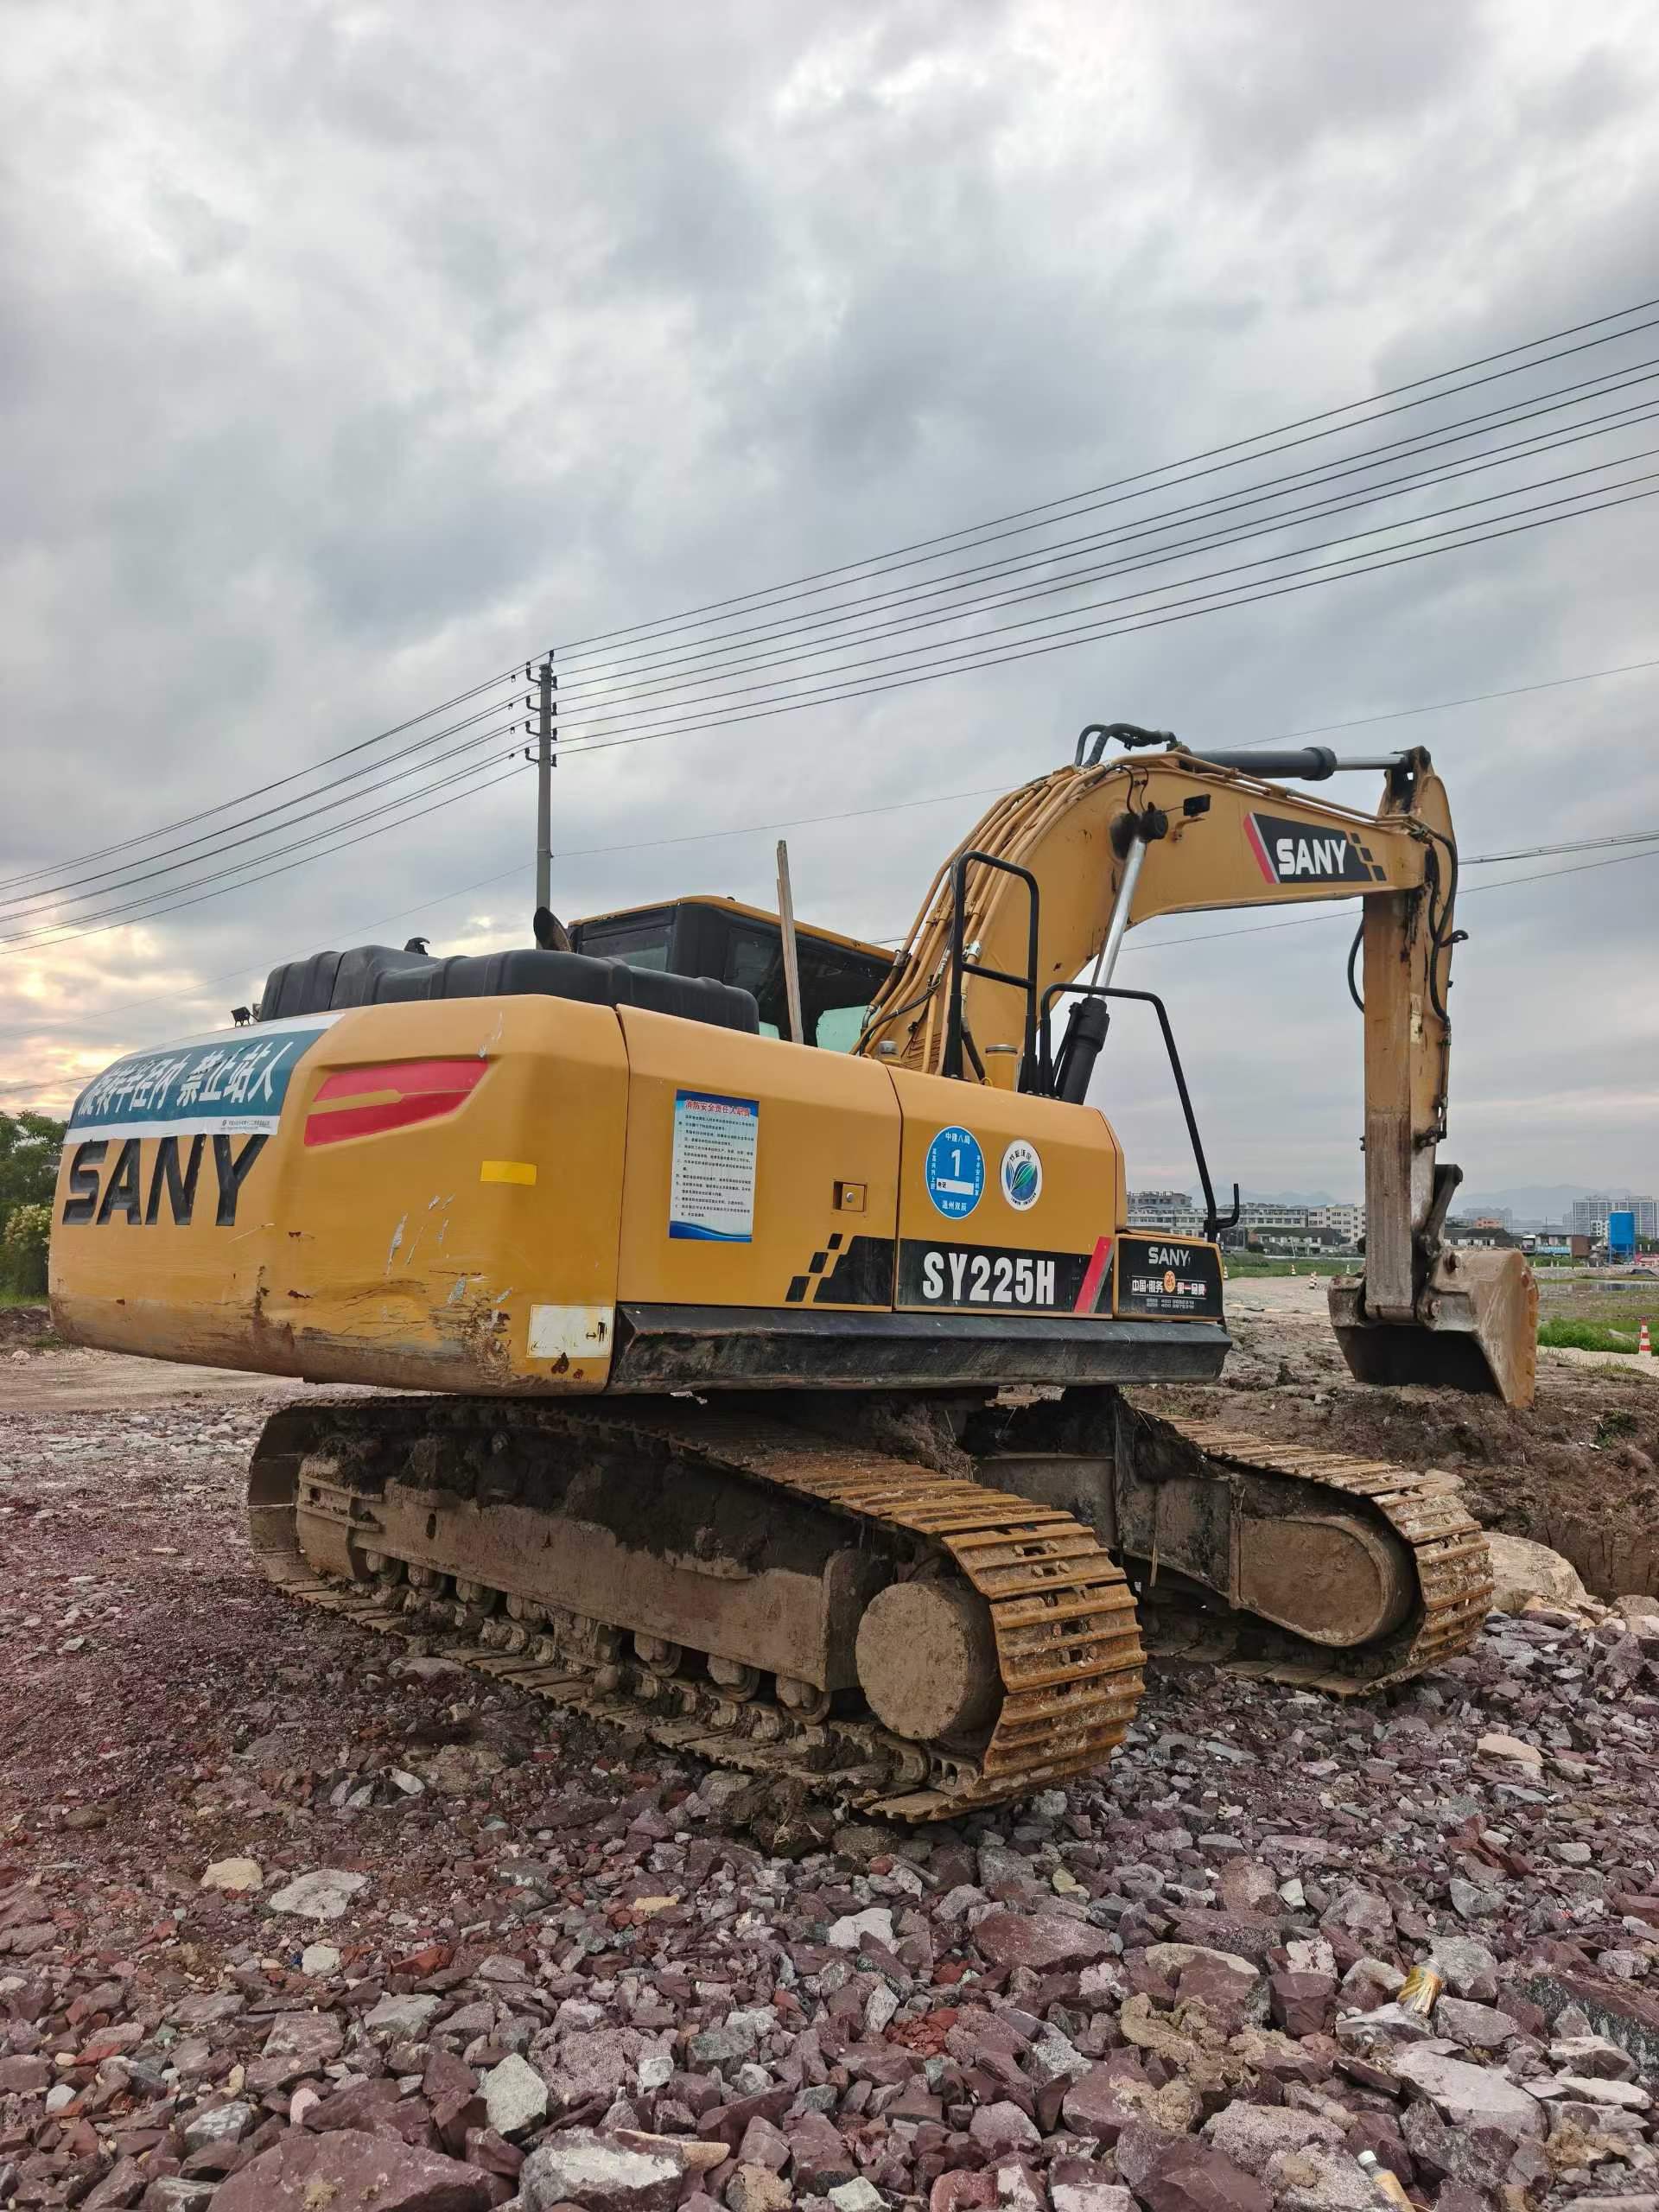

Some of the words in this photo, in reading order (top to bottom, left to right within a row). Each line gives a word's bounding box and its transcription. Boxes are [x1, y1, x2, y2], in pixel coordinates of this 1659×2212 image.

[1275, 838, 1347, 874] SANY
[176, 1040, 294, 1106] 禁止站人
[945, 1131, 970, 1145] 中建八局
[951, 1149, 961, 1177] 1
[62, 1135, 270, 1226] SANY
[942, 1199, 967, 1212] 温州双辰
[1147, 1246, 1190, 1267] SANY
[922, 1251, 1056, 1305] SY225H
